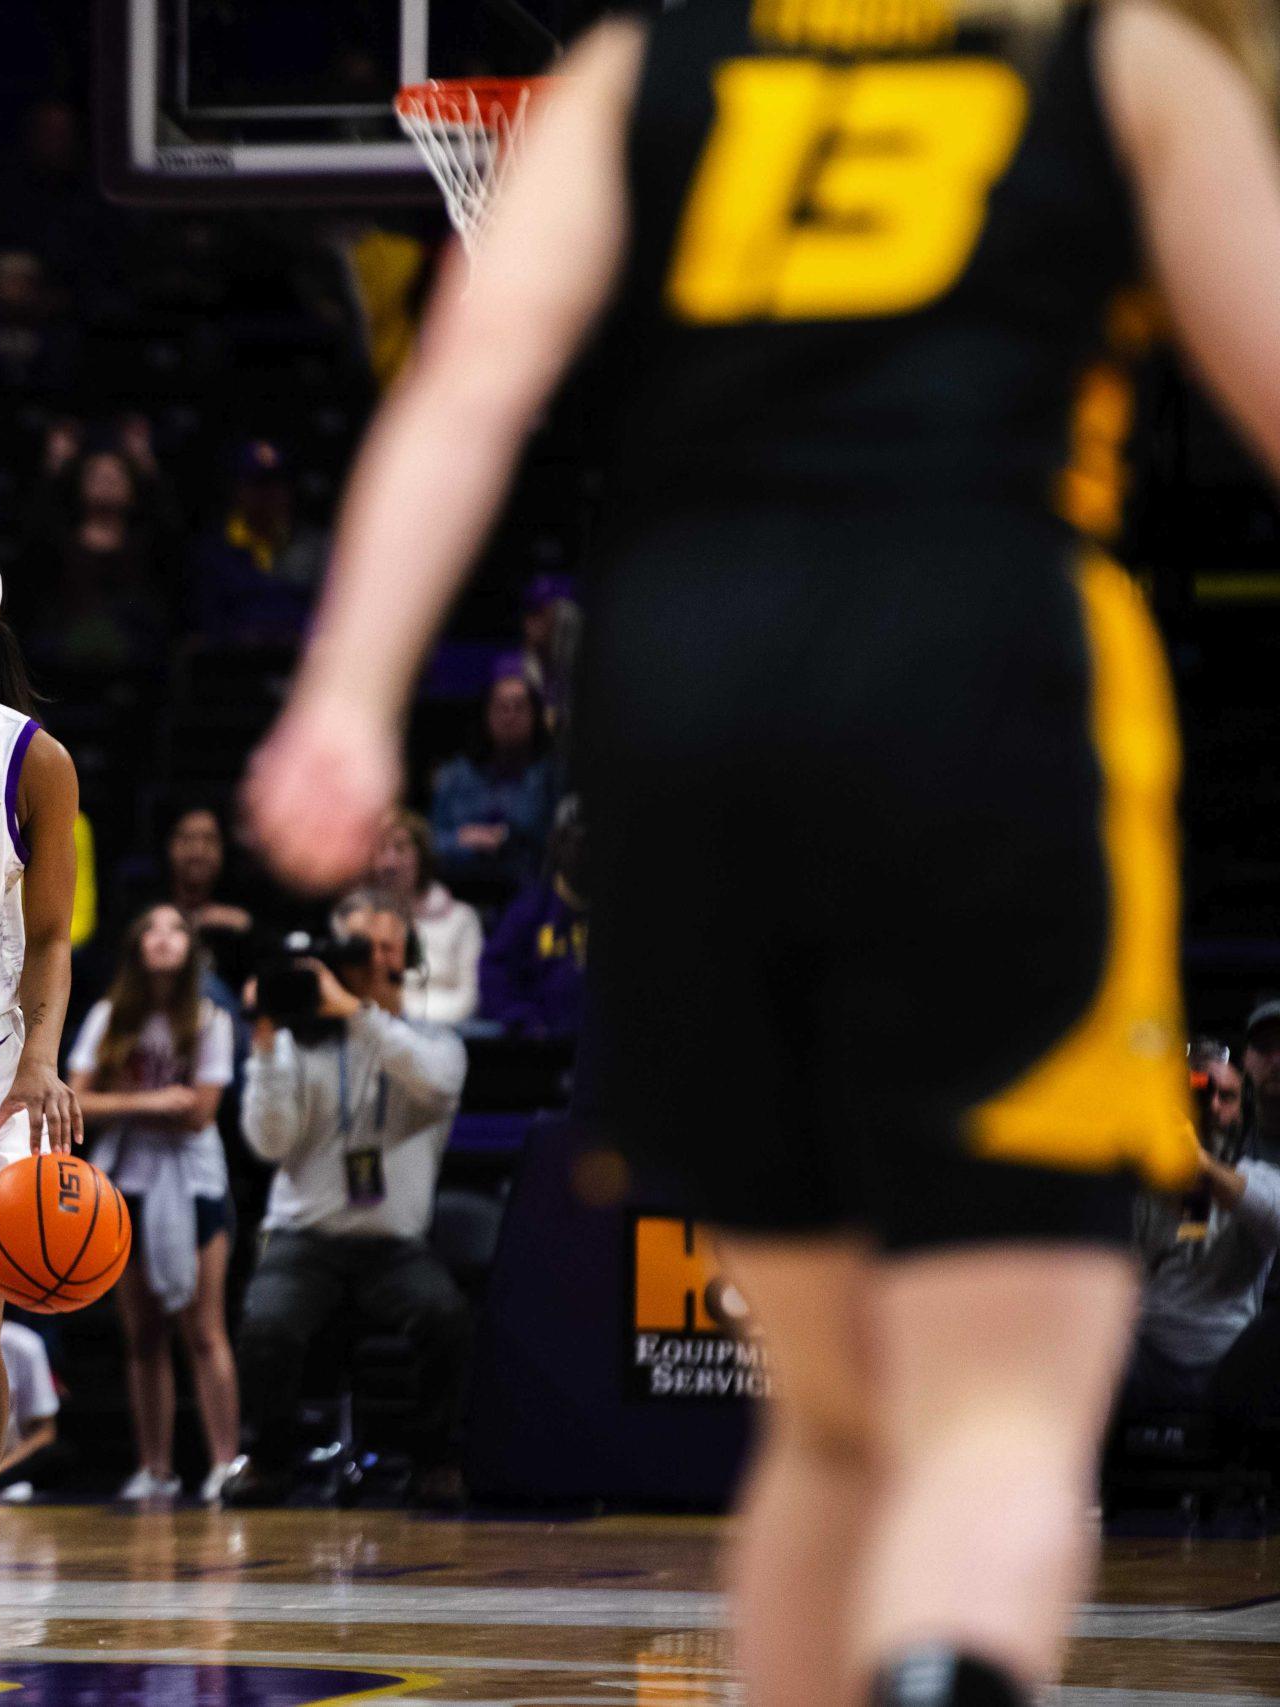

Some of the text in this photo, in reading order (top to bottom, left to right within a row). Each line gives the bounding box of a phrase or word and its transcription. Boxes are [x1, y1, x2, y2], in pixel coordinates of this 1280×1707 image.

[665, 56, 1028, 325] 13
[57, 1161, 81, 1214] LSU
[635, 1334, 767, 1365] EQUIPM
